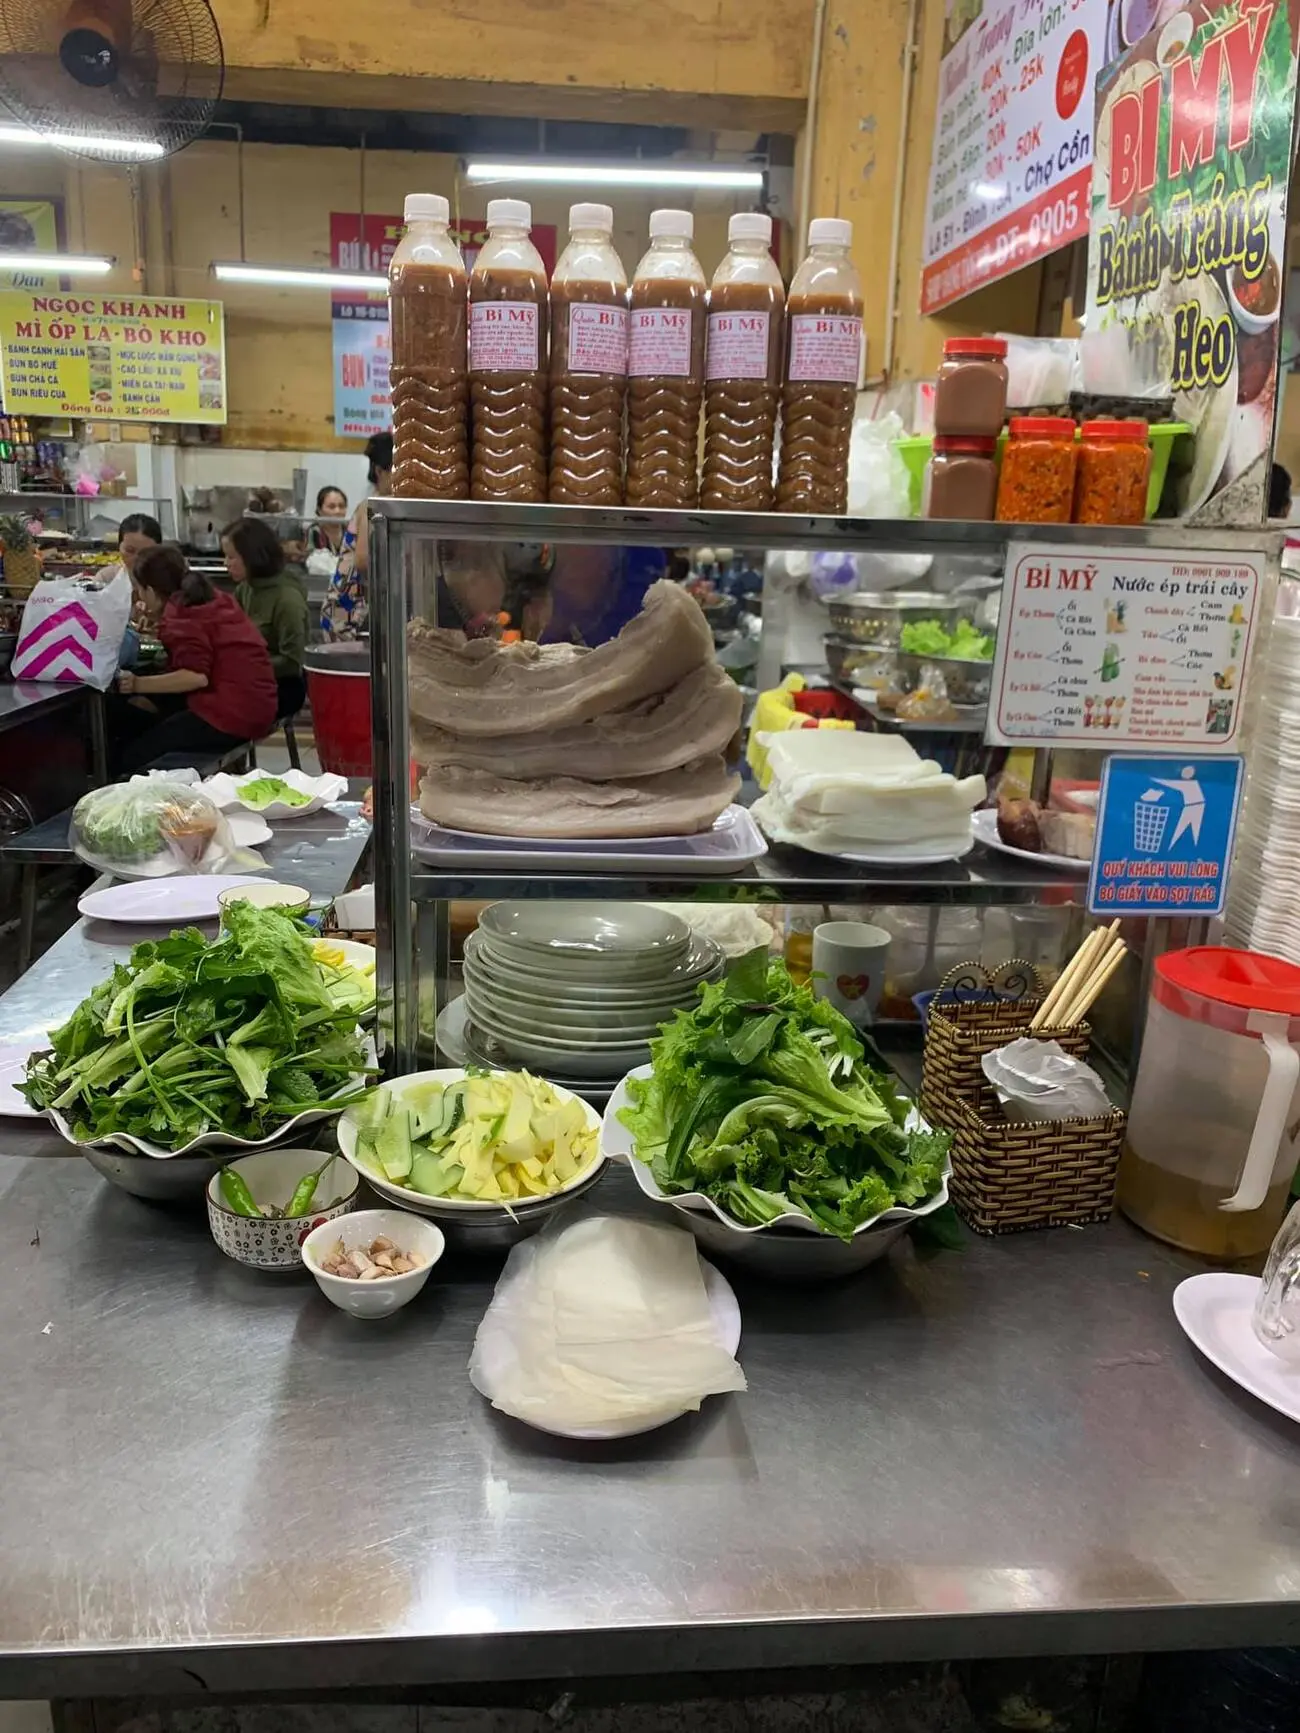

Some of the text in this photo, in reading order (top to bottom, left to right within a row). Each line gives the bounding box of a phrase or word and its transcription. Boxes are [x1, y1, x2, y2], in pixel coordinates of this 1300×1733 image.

[33, 297, 186, 319] NGỌC KHANH
[508, 310, 535, 325] Mỹ
[48, 316, 76, 339] ỐP
[160, 329, 206, 346] KHO
[1171, 300, 1236, 391] Heo
[1057, 564, 1099, 591] MỸ
[1112, 575, 1249, 600] Nước ép trái cây
[1200, 600, 1222, 609] Cam
[1127, 858, 1165, 878] KHÁCH
[1168, 861, 1188, 878] VUI
[1190, 857, 1219, 878] LÒNG
